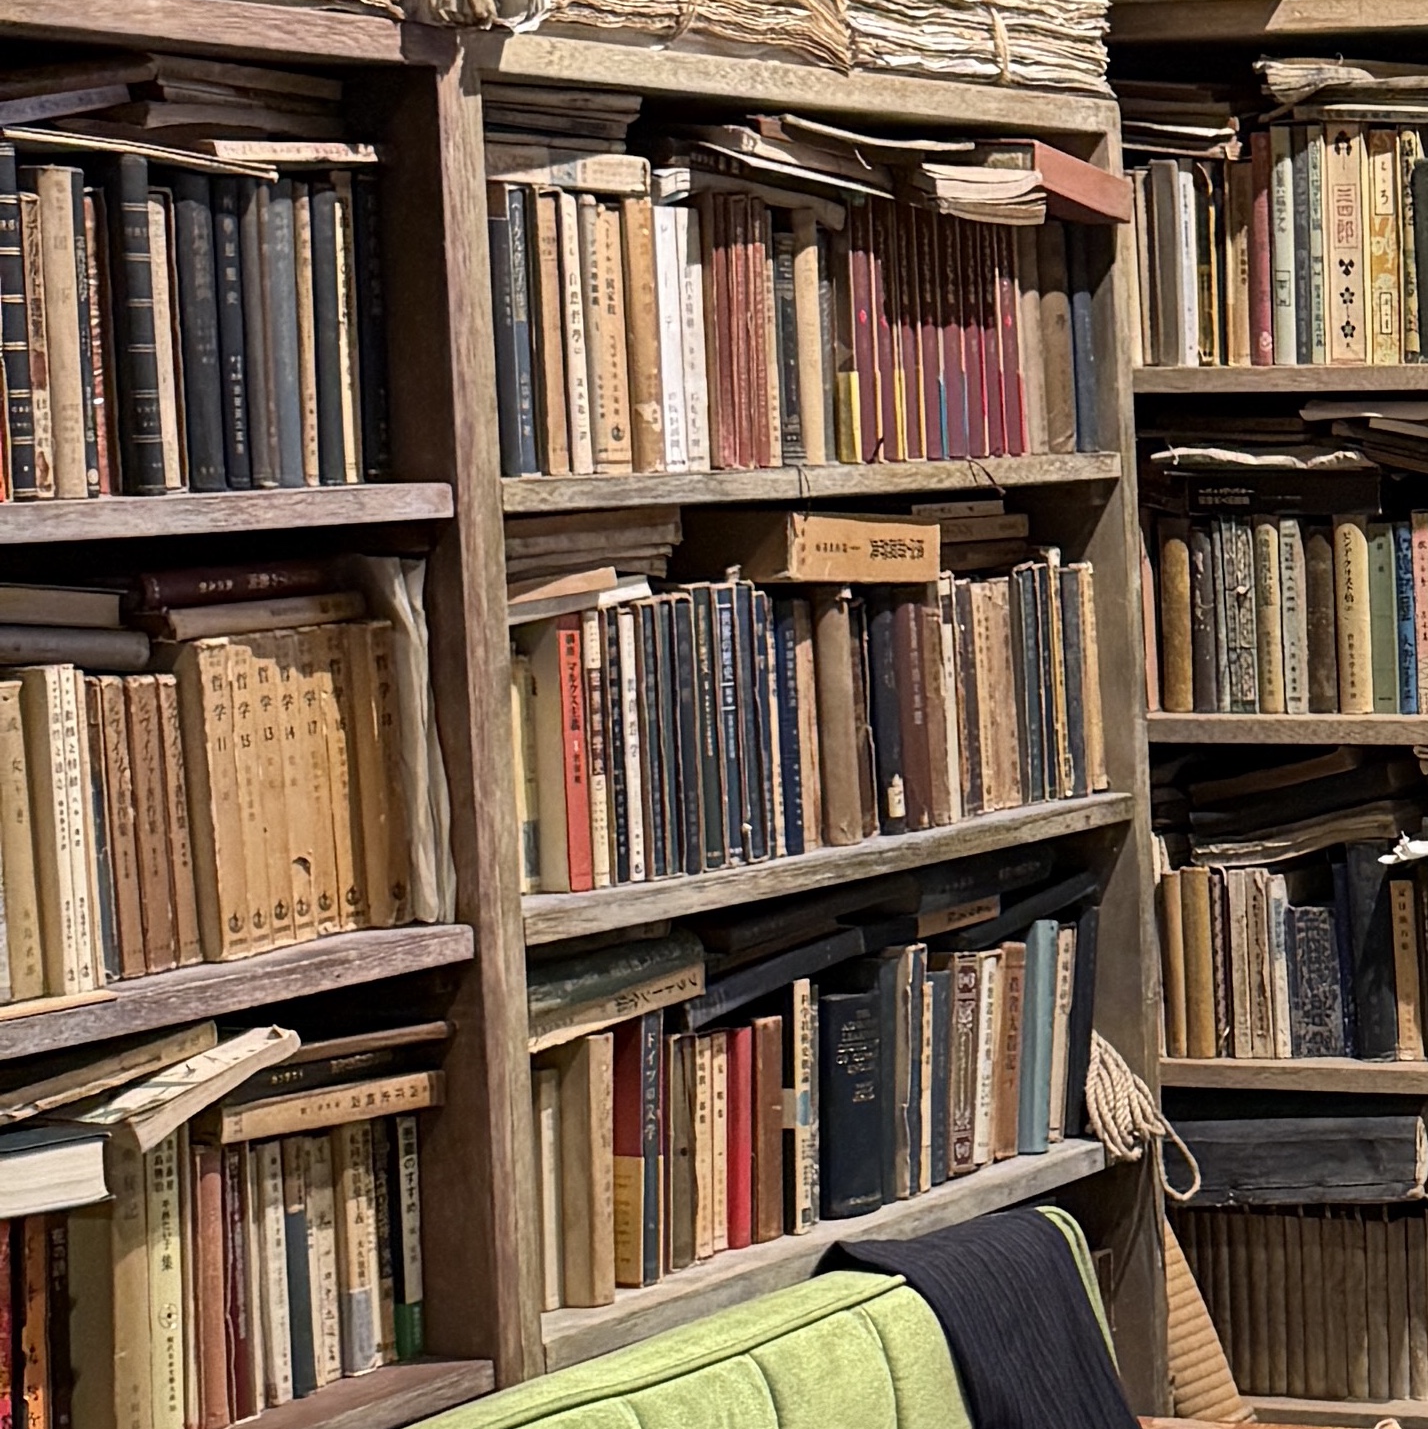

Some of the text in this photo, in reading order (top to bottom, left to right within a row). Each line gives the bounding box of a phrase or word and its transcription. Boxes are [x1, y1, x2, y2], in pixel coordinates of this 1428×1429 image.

[212, 675, 227, 721] 哲学
[237, 672, 251, 719] 哲学
[258, 666, 273, 710] 哲学
[280, 666, 294, 710] 哲学
